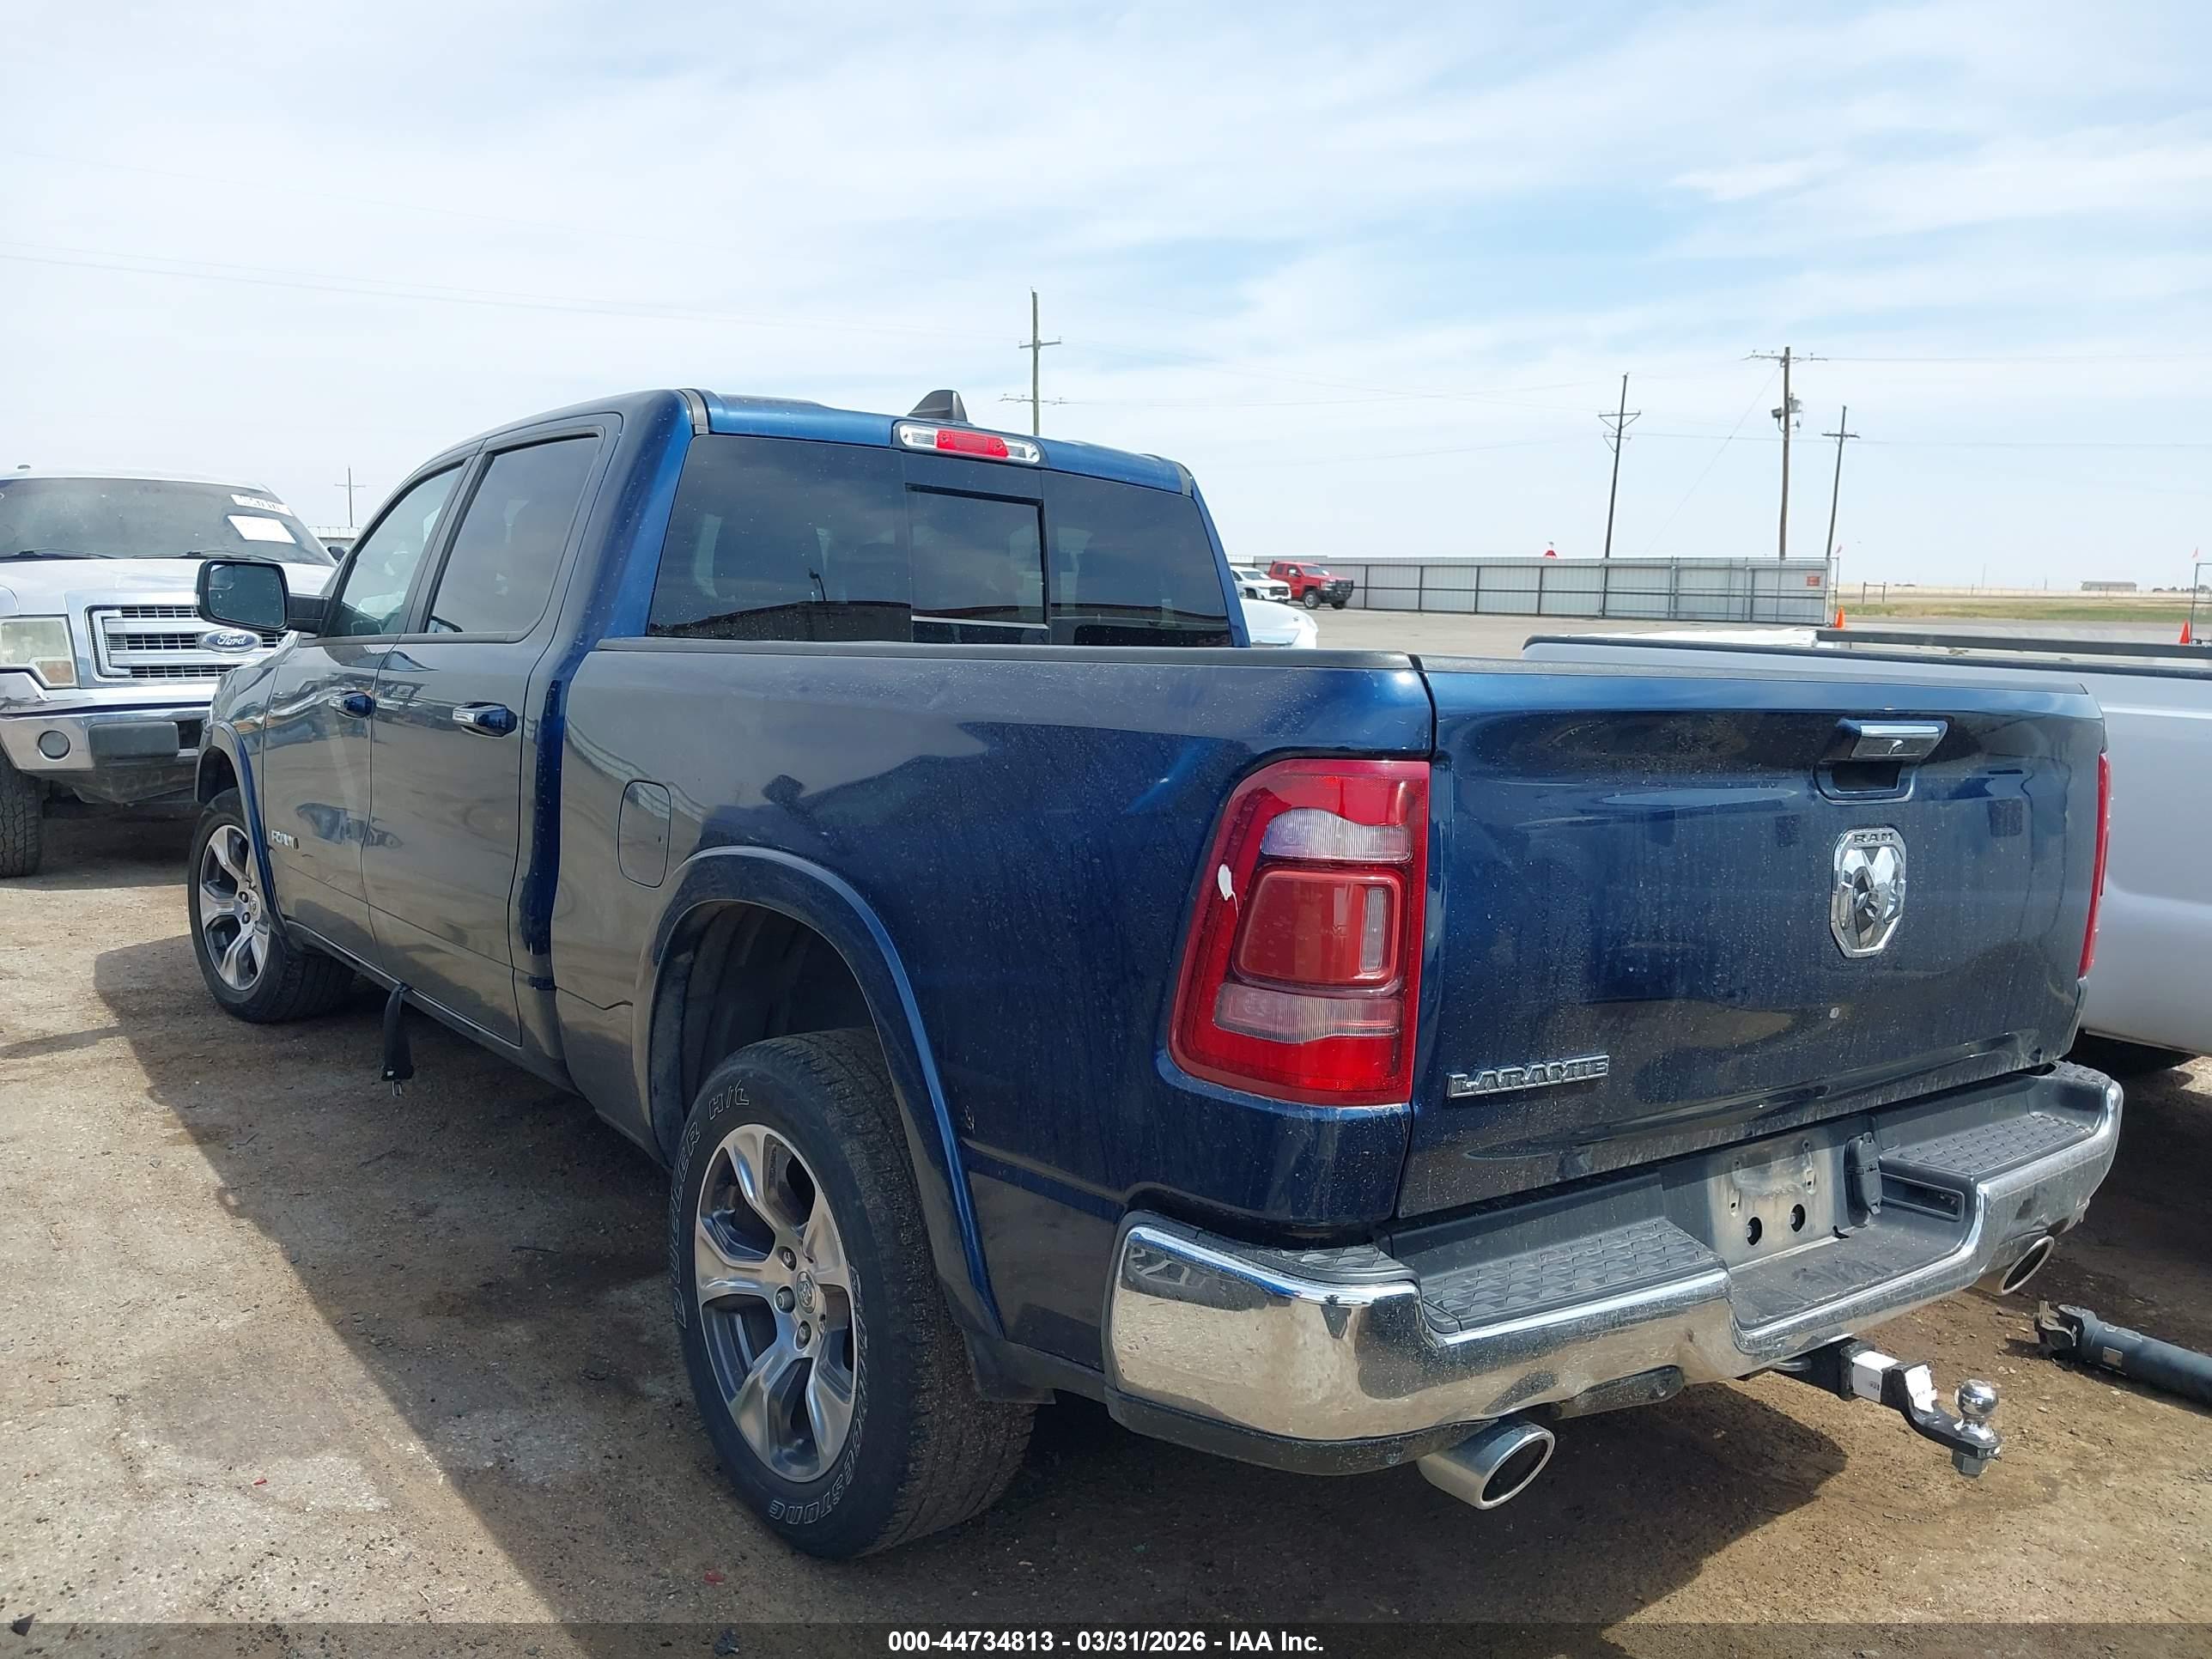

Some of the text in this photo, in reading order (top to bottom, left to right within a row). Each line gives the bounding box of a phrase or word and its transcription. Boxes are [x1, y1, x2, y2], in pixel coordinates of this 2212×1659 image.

[216, 633, 246, 646] Ford
[1854, 833, 1894, 844] RAM
[1446, 1054, 1610, 1097] LARAMIE
[670, 1120, 701, 1329] DUELER
